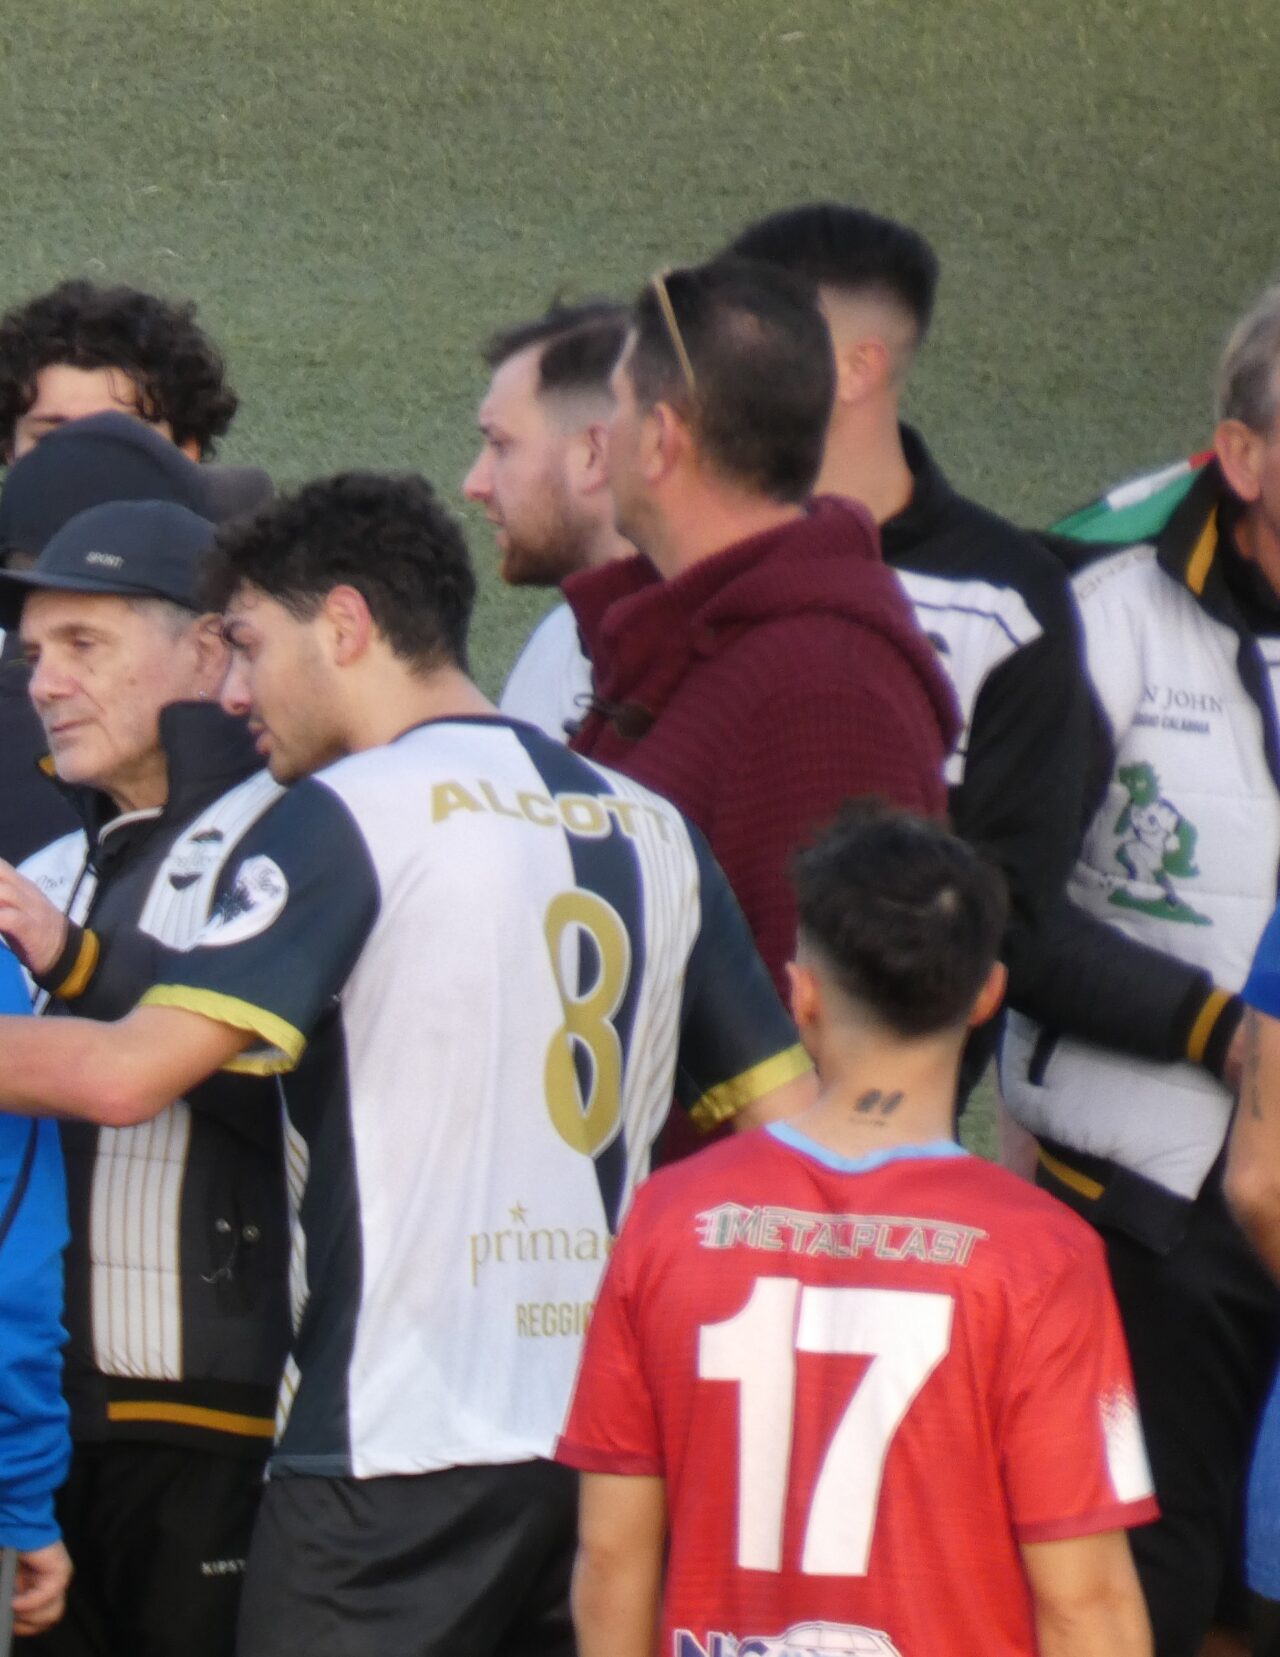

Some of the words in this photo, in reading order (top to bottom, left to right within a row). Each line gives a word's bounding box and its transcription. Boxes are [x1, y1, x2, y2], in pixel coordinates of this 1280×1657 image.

[1165, 687, 1225, 714] JOHN
[430, 778, 671, 841] ALCOTT
[543, 887, 631, 1158] 8
[724, 1203, 988, 1265] METALPLAST
[699, 1276, 955, 1577] 17
